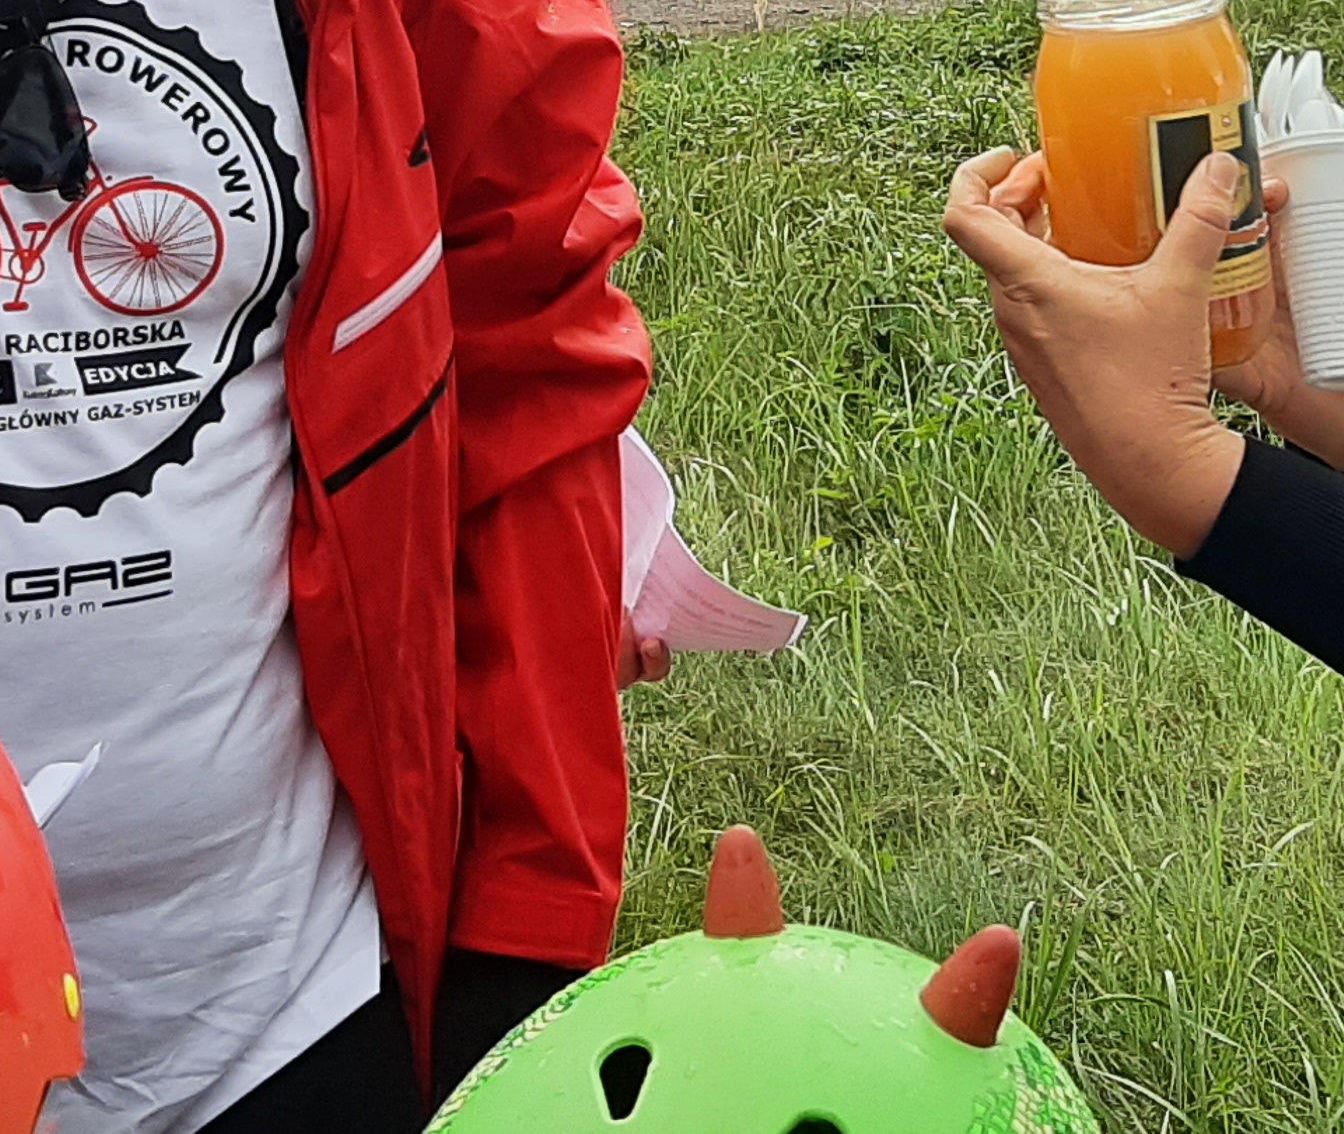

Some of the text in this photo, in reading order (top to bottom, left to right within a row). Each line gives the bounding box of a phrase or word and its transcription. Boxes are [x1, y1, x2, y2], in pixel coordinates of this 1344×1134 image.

[66, 39, 256, 223] ROWEROWY
[5, 320, 186, 355] RACIBORSKA
[83, 360, 175, 385] EDYCJA
[87, 390, 202, 421] GAZ-SYSTEM
[5, 550, 172, 603] GAZ
[4, 601, 96, 624] system
